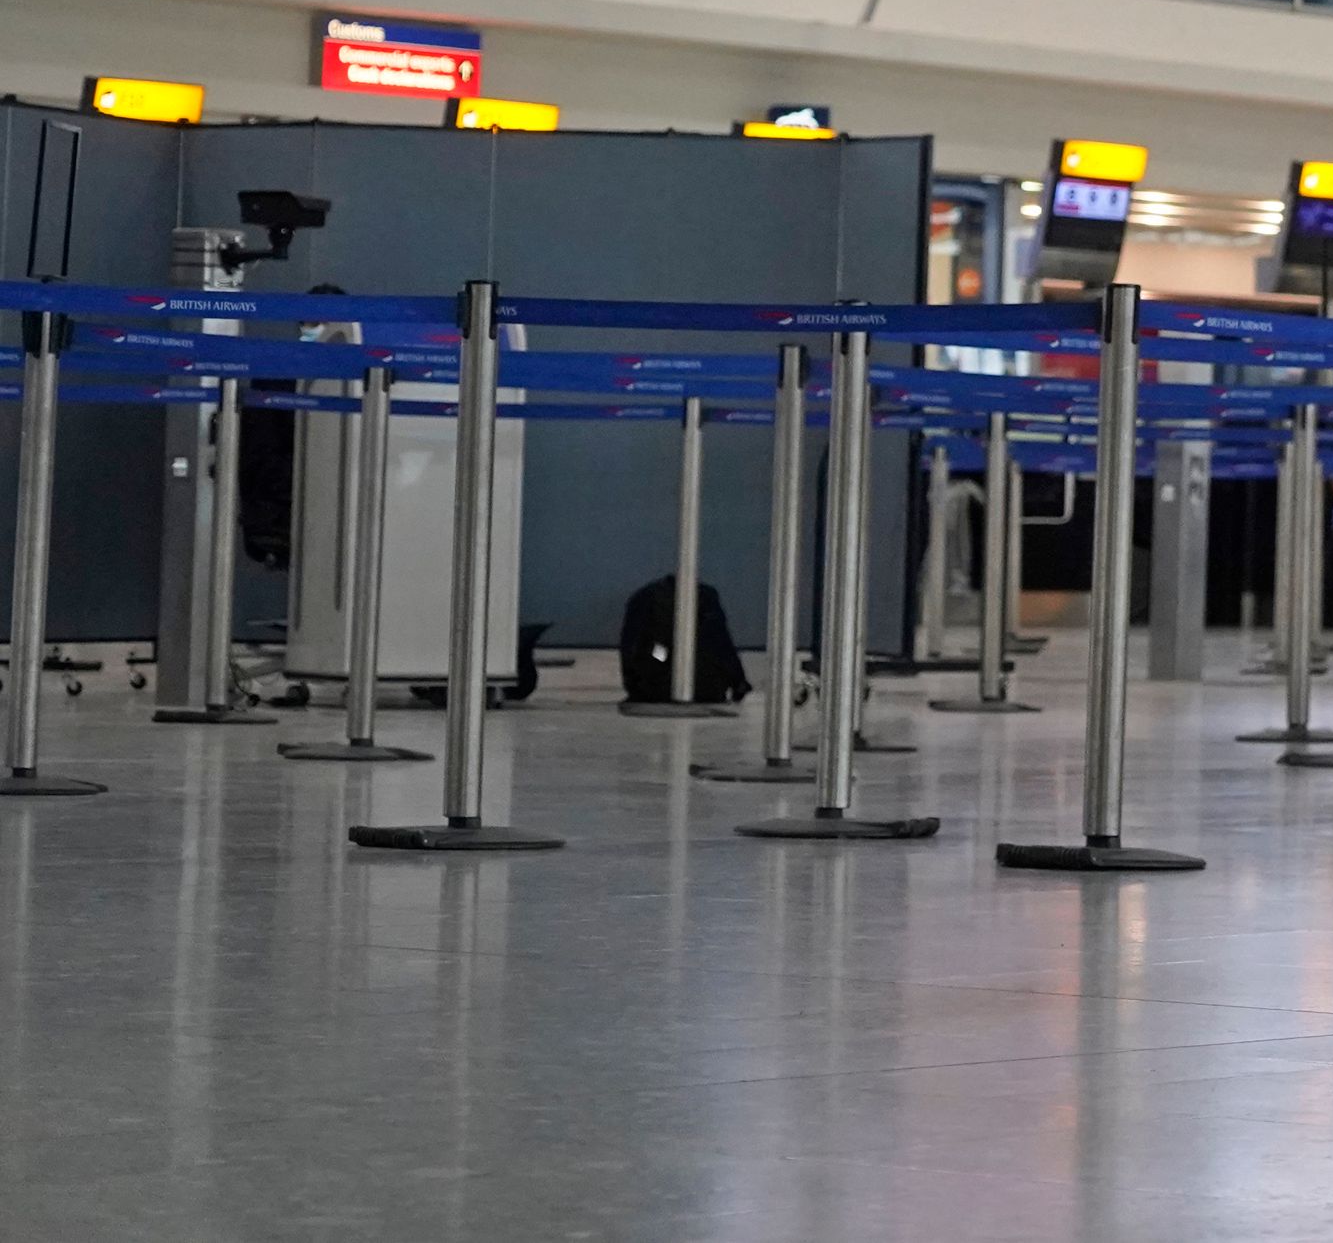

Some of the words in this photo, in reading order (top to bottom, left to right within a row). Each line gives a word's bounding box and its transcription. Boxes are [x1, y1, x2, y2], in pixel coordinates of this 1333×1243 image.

[327, 18, 385, 43] Customs
[169, 299, 211, 311] BRITISH
[211, 301, 257, 313] AIRWAYS
[796, 314, 840, 324] BRITISH
[841, 314, 887, 325] AIRWAYS
[1206, 317, 1239, 329] BRITISH
[1240, 319, 1273, 332] AIRWAYS
[127, 333, 160, 346] BRITISH
[160, 336, 194, 348] AIRWAYS
